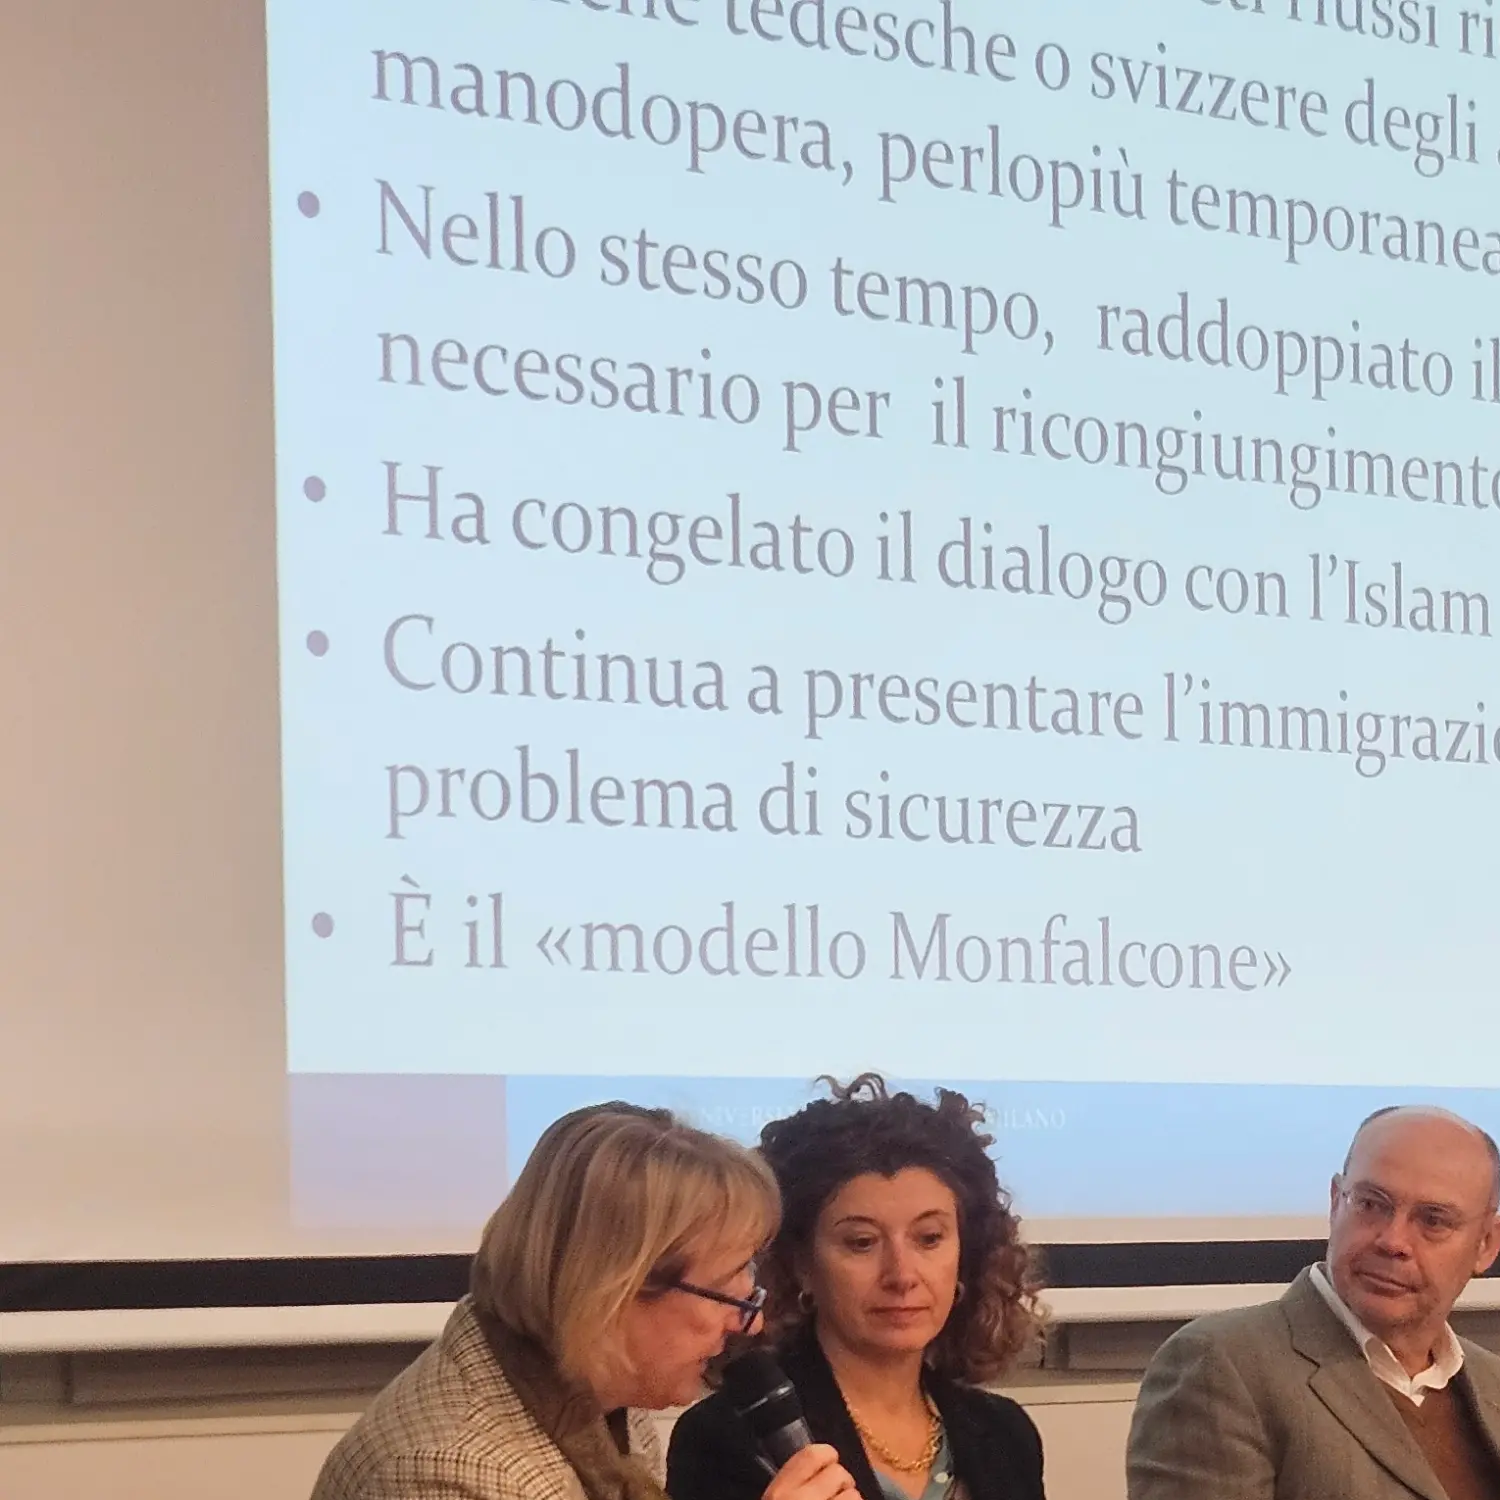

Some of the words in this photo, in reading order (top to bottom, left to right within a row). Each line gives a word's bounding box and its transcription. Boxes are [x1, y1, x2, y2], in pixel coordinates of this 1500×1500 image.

[370, 48, 854, 187] manodopera,
[877, 123, 1148, 230] perlopiù
[726, 0, 1017, 83] tedesche
[1034, 42, 1071, 92] o
[1090, 41, 1329, 138] svizzere
[1344, 76, 1480, 179] degli
[374, 178, 577, 279] Nello
[599, 227, 808, 310] stesso
[829, 256, 1055, 356] tempo,
[1096, 290, 1453, 402] raddoppiato
[376, 332, 761, 425] necessario
[781, 380, 891, 454] per
[931, 375, 970, 450] il
[380, 460, 492, 546] Ha
[511, 491, 855, 586] congelato
[876, 509, 918, 584] il
[937, 516, 1168, 626] dialogo
[1184, 564, 1291, 619] con
[1308, 552, 1493, 638] l’Islam
[383, 613, 730, 712] Continua
[747, 664, 784, 716] a
[802, 668, 1144, 741] presentare
[384, 743, 739, 840] problema
[758, 760, 823, 837] di
[844, 769, 1143, 853] sicurezza
[388, 876, 434, 968] È
[463, 891, 508, 969] il
[535, 900, 866, 980] «modello
[888, 910, 1292, 992] Monfalcone»
